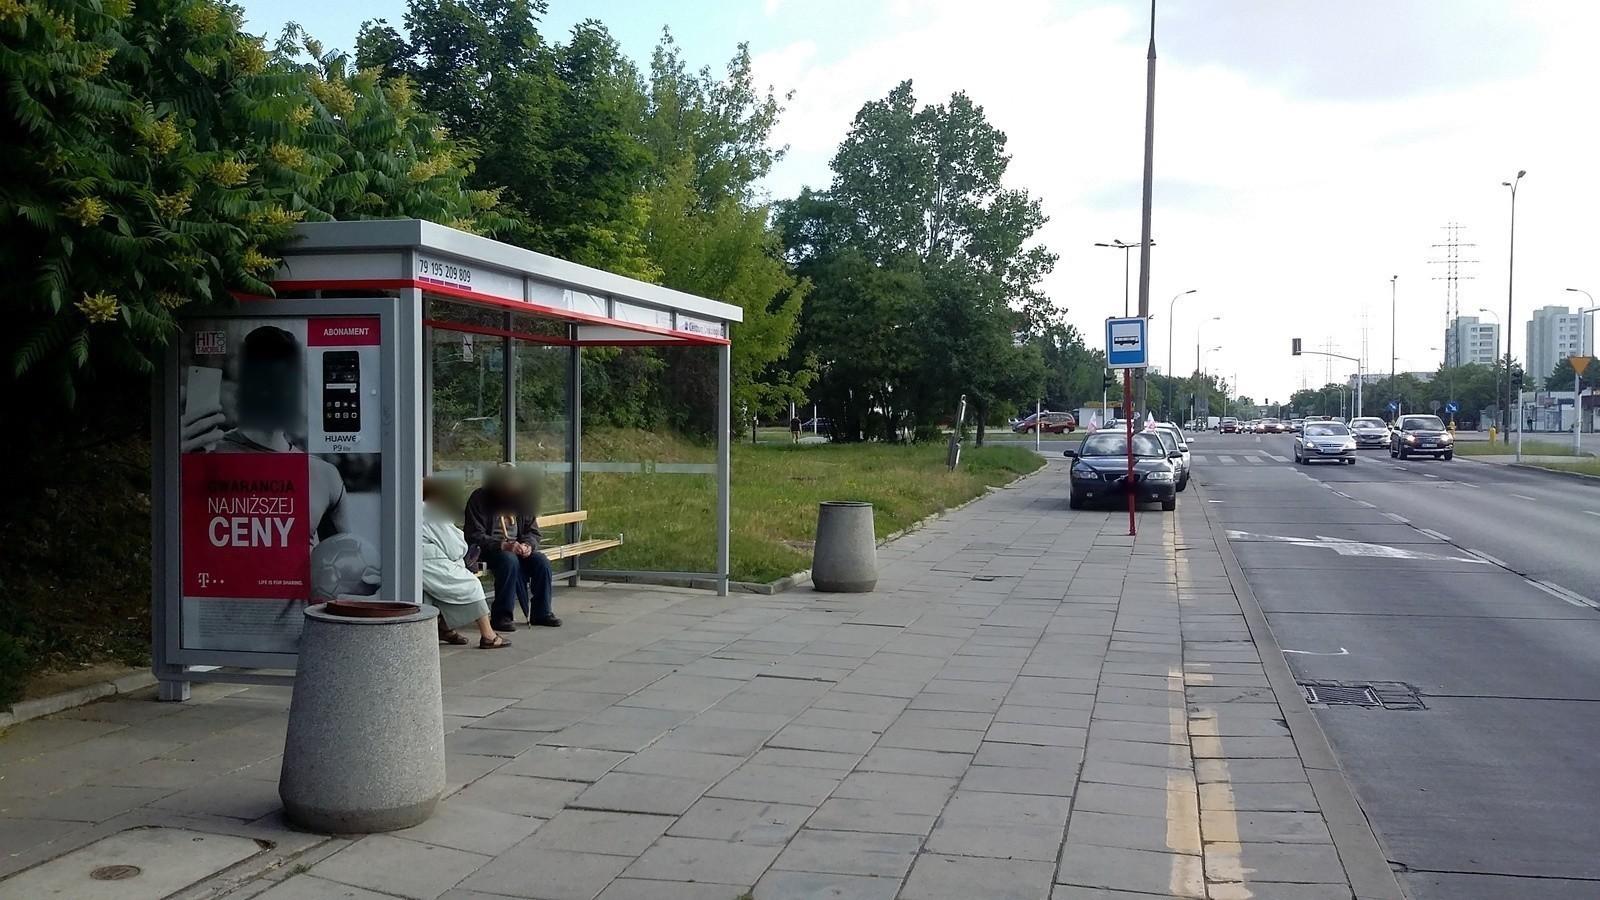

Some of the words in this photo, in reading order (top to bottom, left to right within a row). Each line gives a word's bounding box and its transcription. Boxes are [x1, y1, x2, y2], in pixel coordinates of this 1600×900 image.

[419, 260, 428, 273] 79
[431, 262, 443, 276] 195
[445, 266, 457, 280] 209
[459, 269, 471, 282] 809
[197, 331, 217, 346] HIT
[324, 328, 369, 336] ABONAMENT
[325, 435, 358, 443] HUAWE
[208, 494, 294, 514] NAJNIŻSZEJ
[208, 516, 295, 547] CENY
